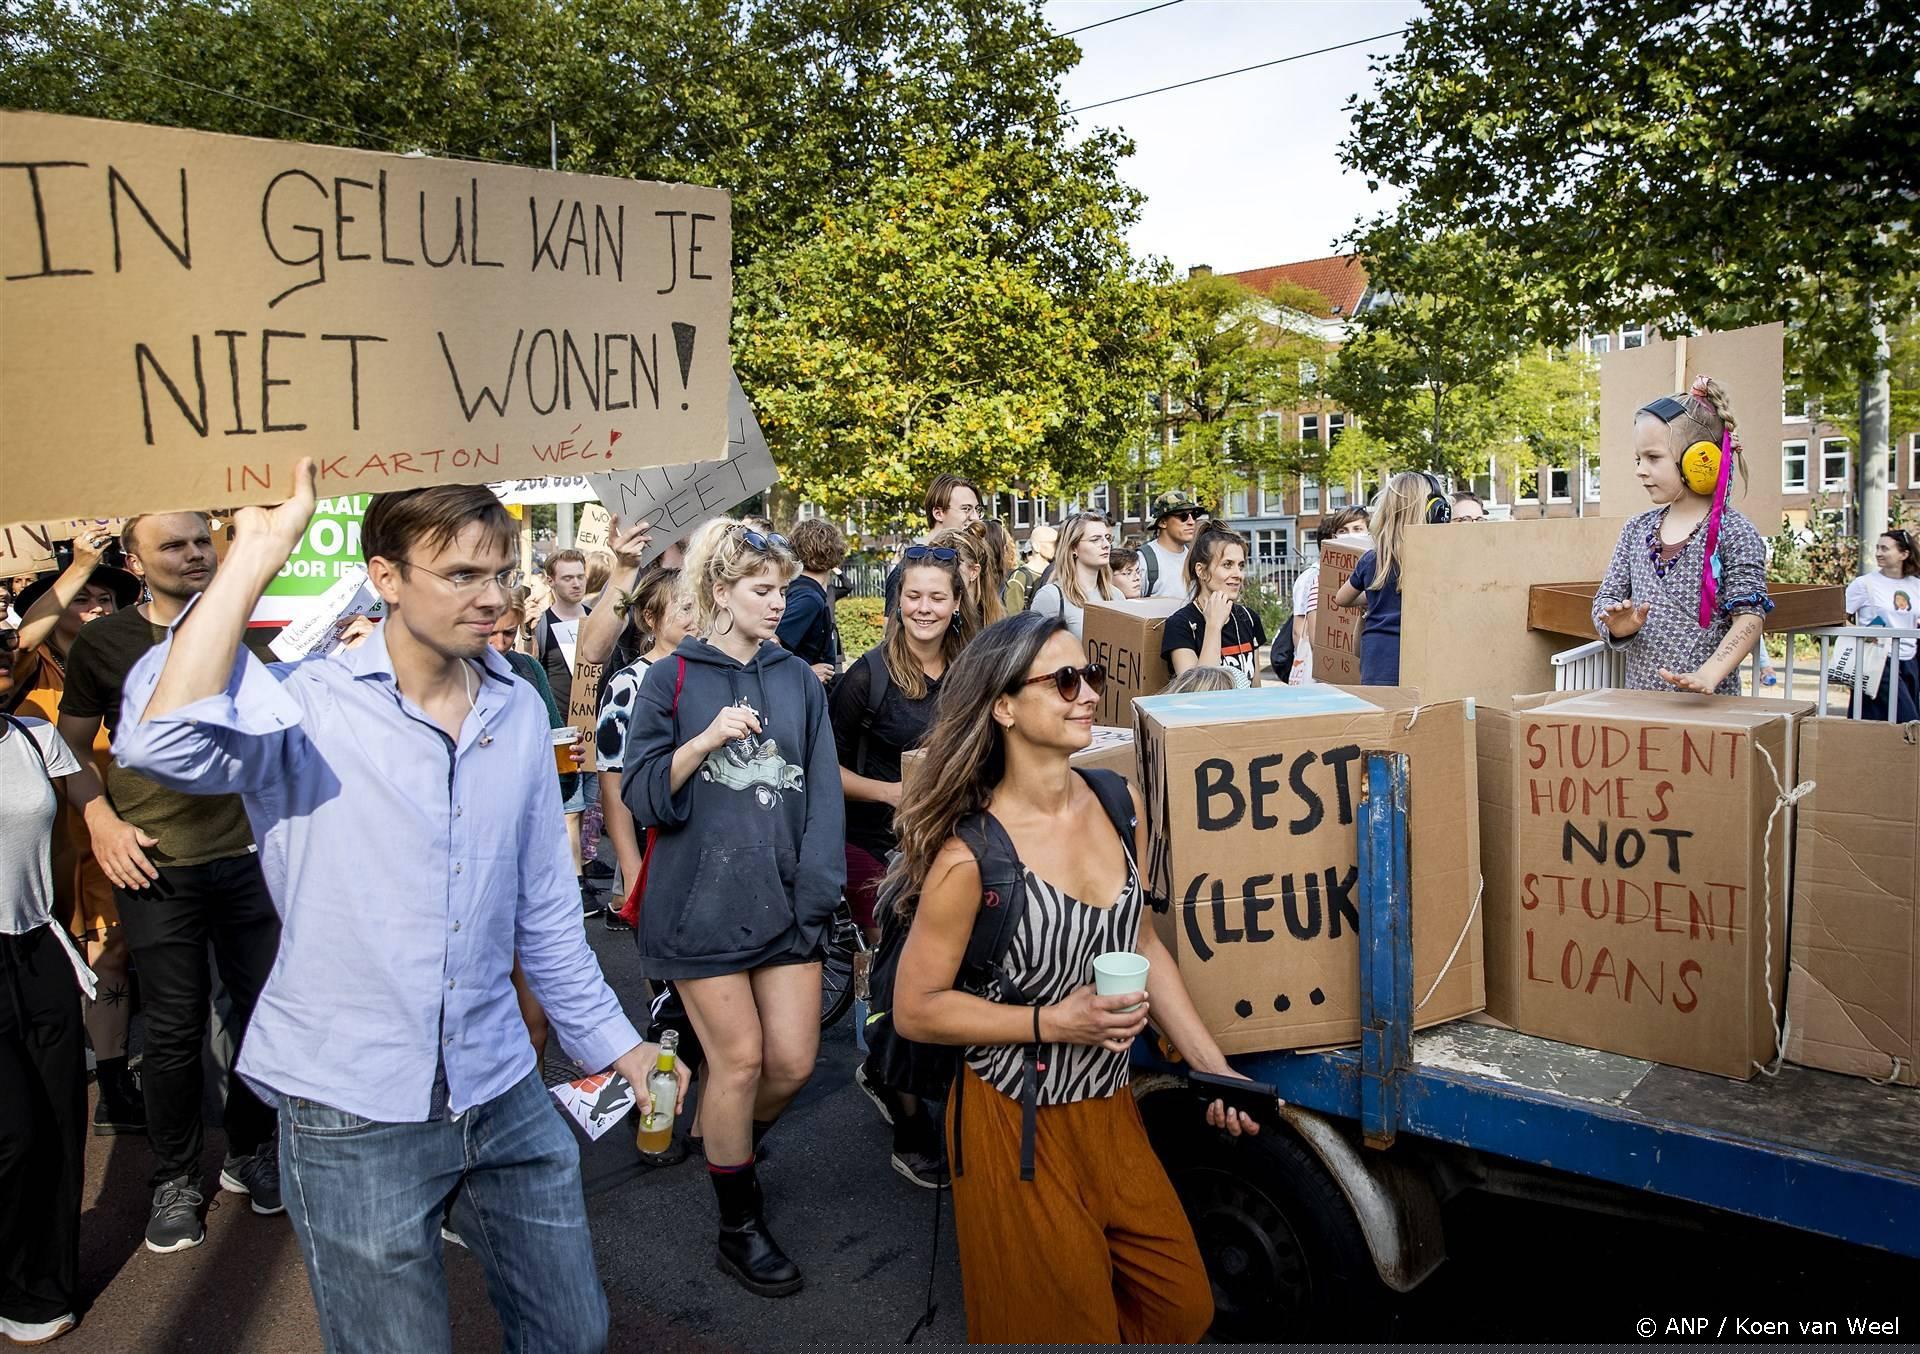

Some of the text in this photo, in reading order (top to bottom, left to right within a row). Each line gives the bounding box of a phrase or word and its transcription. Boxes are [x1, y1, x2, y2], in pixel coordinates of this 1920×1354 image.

[0, 160, 716, 308] IN GELUL KAN JE
[135, 321, 697, 445] NIET WONEN!
[226, 465, 271, 493] IN
[321, 443, 501, 480] KARTON
[1338, 615, 1350, 625] THE
[1341, 658, 1351, 674] IS
[1526, 721, 1747, 781] STUDENT
[1195, 743, 1362, 837] BEST
[1528, 776, 1675, 823] HOMES
[1561, 820, 1695, 875] NOT
[1521, 872, 1747, 947] STUDENT
[1526, 930, 1704, 1014] LOANS
